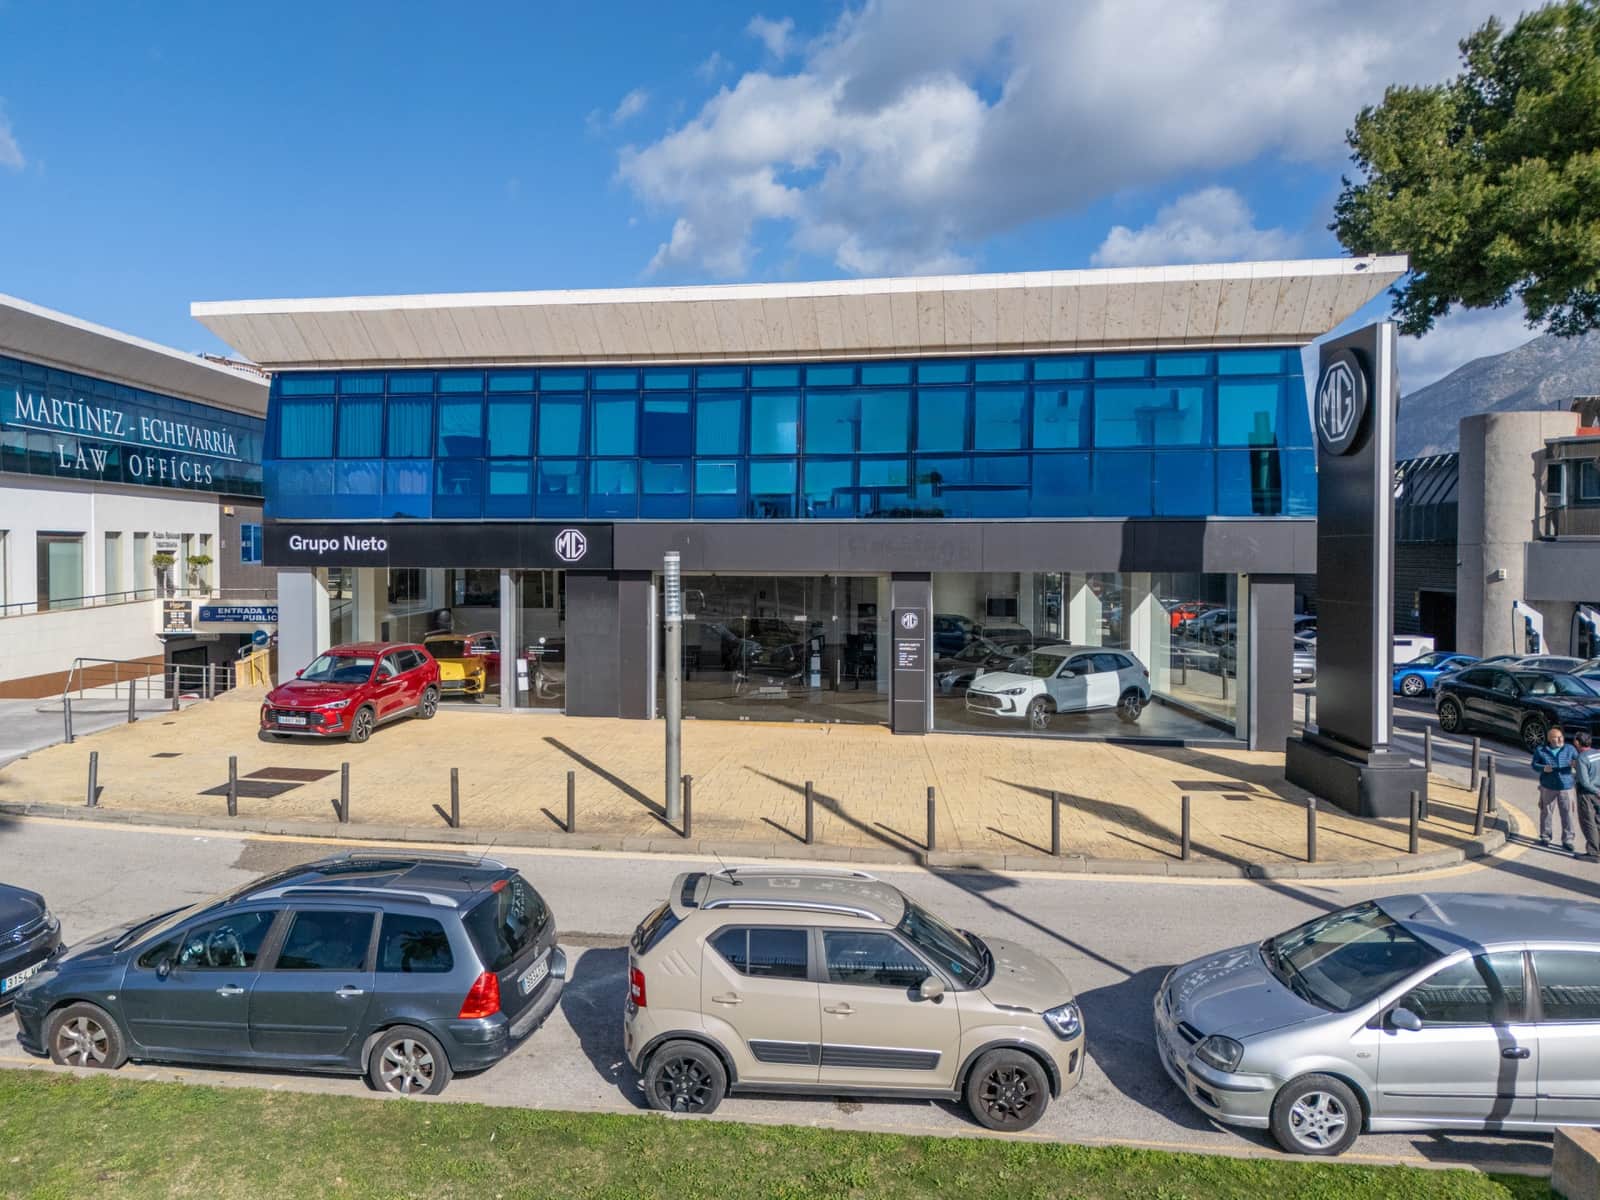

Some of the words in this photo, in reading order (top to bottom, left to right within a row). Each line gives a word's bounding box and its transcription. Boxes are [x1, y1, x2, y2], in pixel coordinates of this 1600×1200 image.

[1322, 368, 1353, 435] MG
[15, 391, 125, 437] MARTÍNEZ
[141, 416, 237, 456] ECHEVARRÍA
[58, 443, 108, 473] LAW
[289, 535, 340, 555] Grupo
[343, 535, 388, 551] Nieto
[558, 531, 584, 559] MG
[218, 607, 263, 615] ENTRADA
[901, 613, 918, 629] MG
